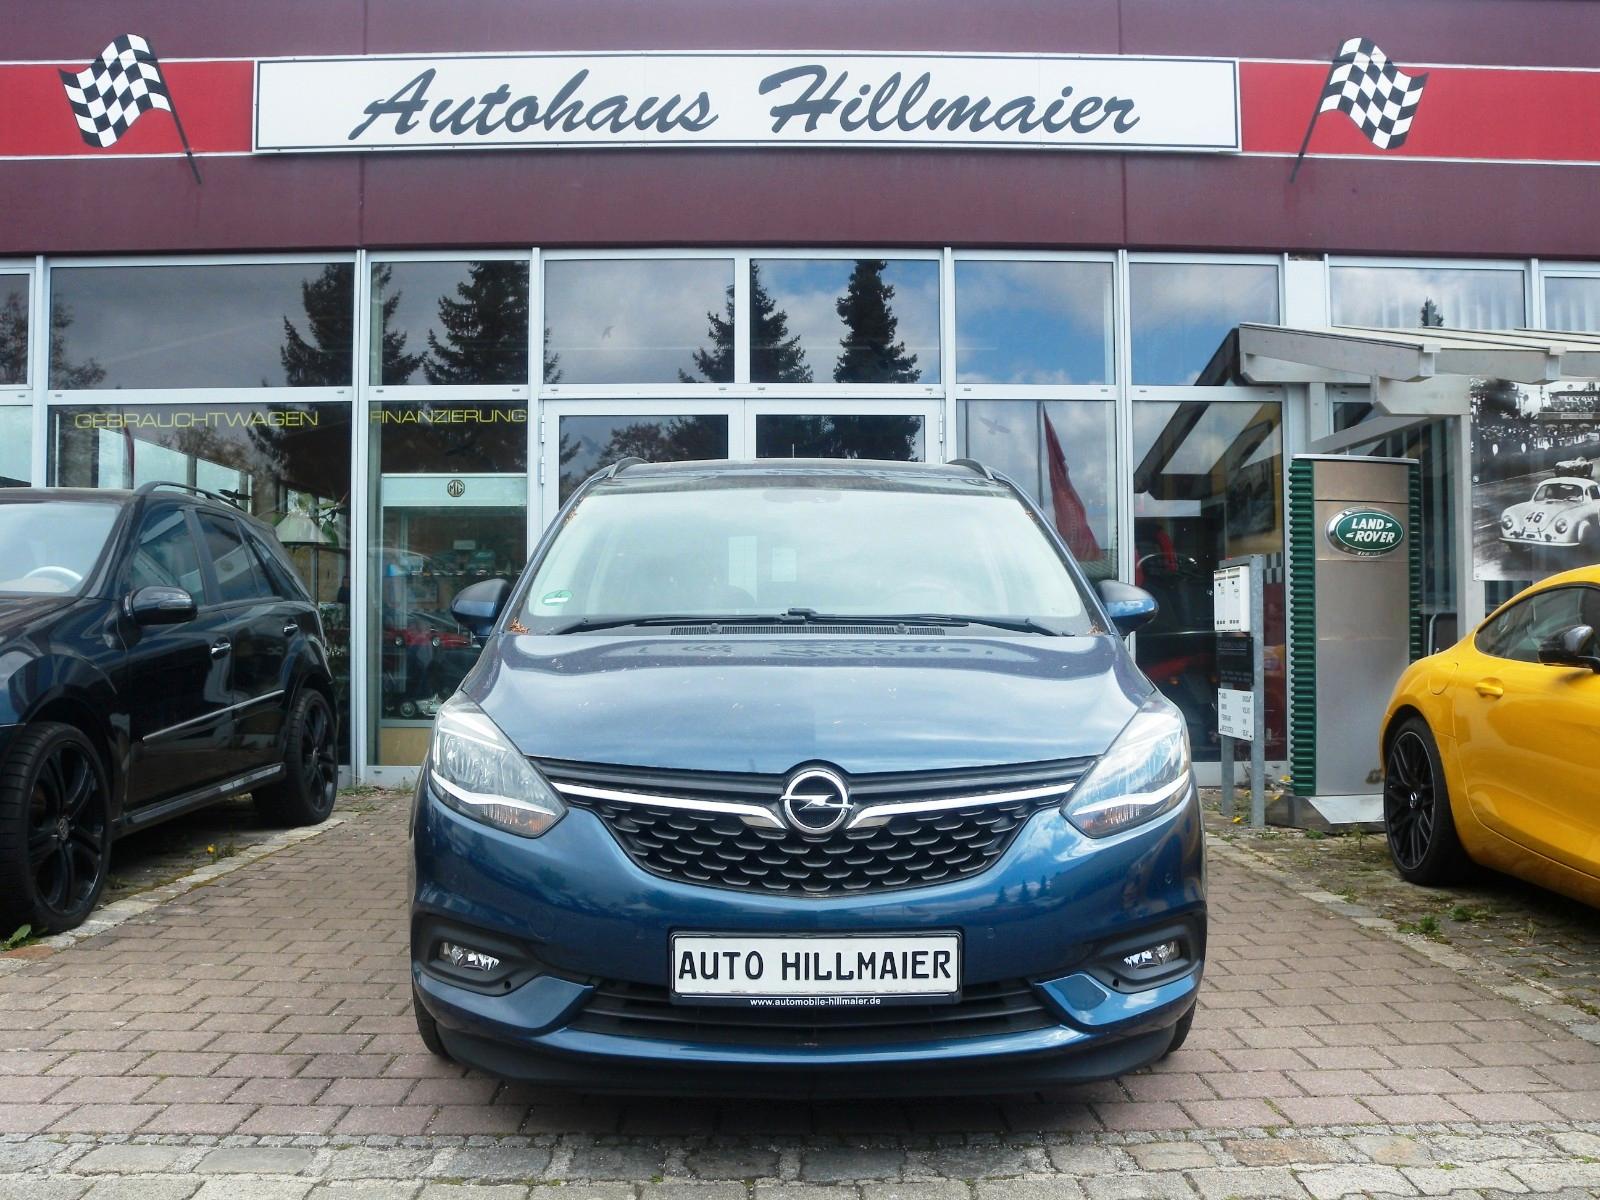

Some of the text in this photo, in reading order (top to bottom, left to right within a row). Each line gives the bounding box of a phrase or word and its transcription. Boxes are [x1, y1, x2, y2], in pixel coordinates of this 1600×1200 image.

[347, 64, 1140, 141] Autohaus Hillmaier
[74, 411, 318, 429] GEBRAUCHTWAGEN
[370, 409, 527, 424] FINANZIERUNG
[449, 480, 464, 497] MG
[1351, 517, 1385, 530] LAND
[1525, 511, 1544, 523] 46
[1354, 530, 1395, 543] ROVER
[678, 950, 951, 980] AUTO HILLMAIER
[749, 996, 881, 1006] www.automobile-hillmaier.de
